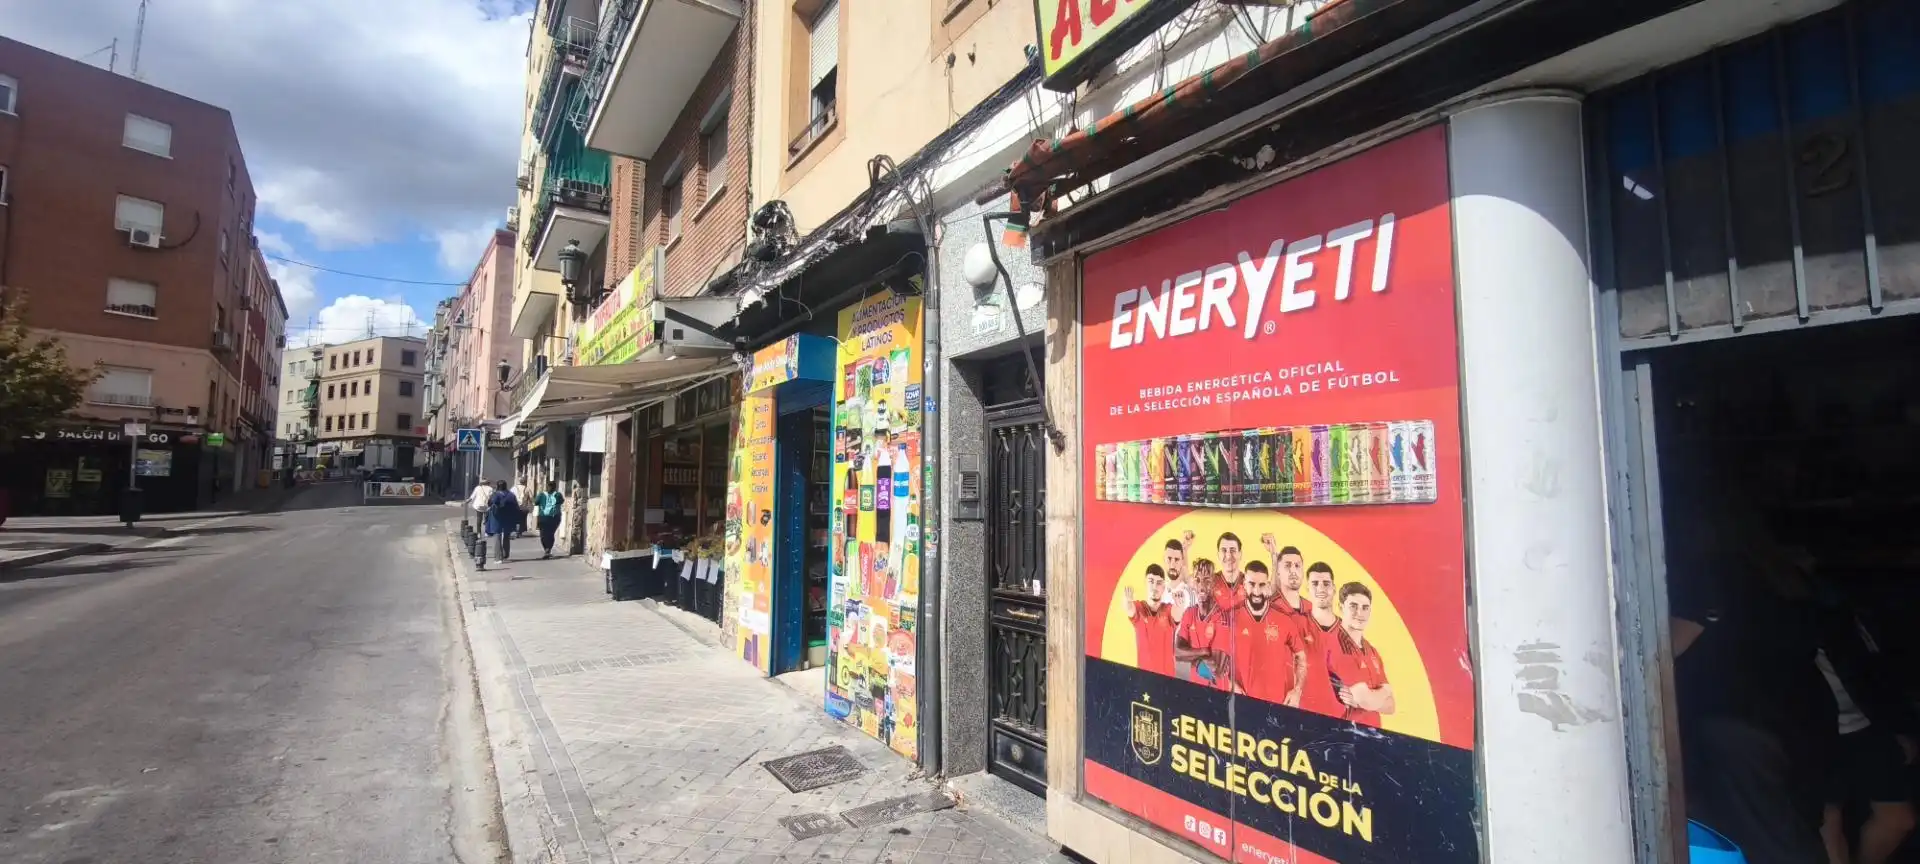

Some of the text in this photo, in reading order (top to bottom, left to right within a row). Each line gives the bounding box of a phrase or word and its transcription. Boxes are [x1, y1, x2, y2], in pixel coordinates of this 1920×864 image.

[1110, 212, 1395, 349] ENERYETI
[856, 308, 904, 335] PRODUCTOS
[862, 330, 892, 351] LATINOS
[1109, 371, 1400, 416] DE LA SELECCIÓN ESPAÑOLA DE FÚTBOL
[1139, 360, 1345, 399] BEBIDA ENERGÉTICA OFICIAL
[1180, 714, 1363, 797] ENERGÍA DE LA
[1171, 744, 1373, 843] SELECCIÓN
